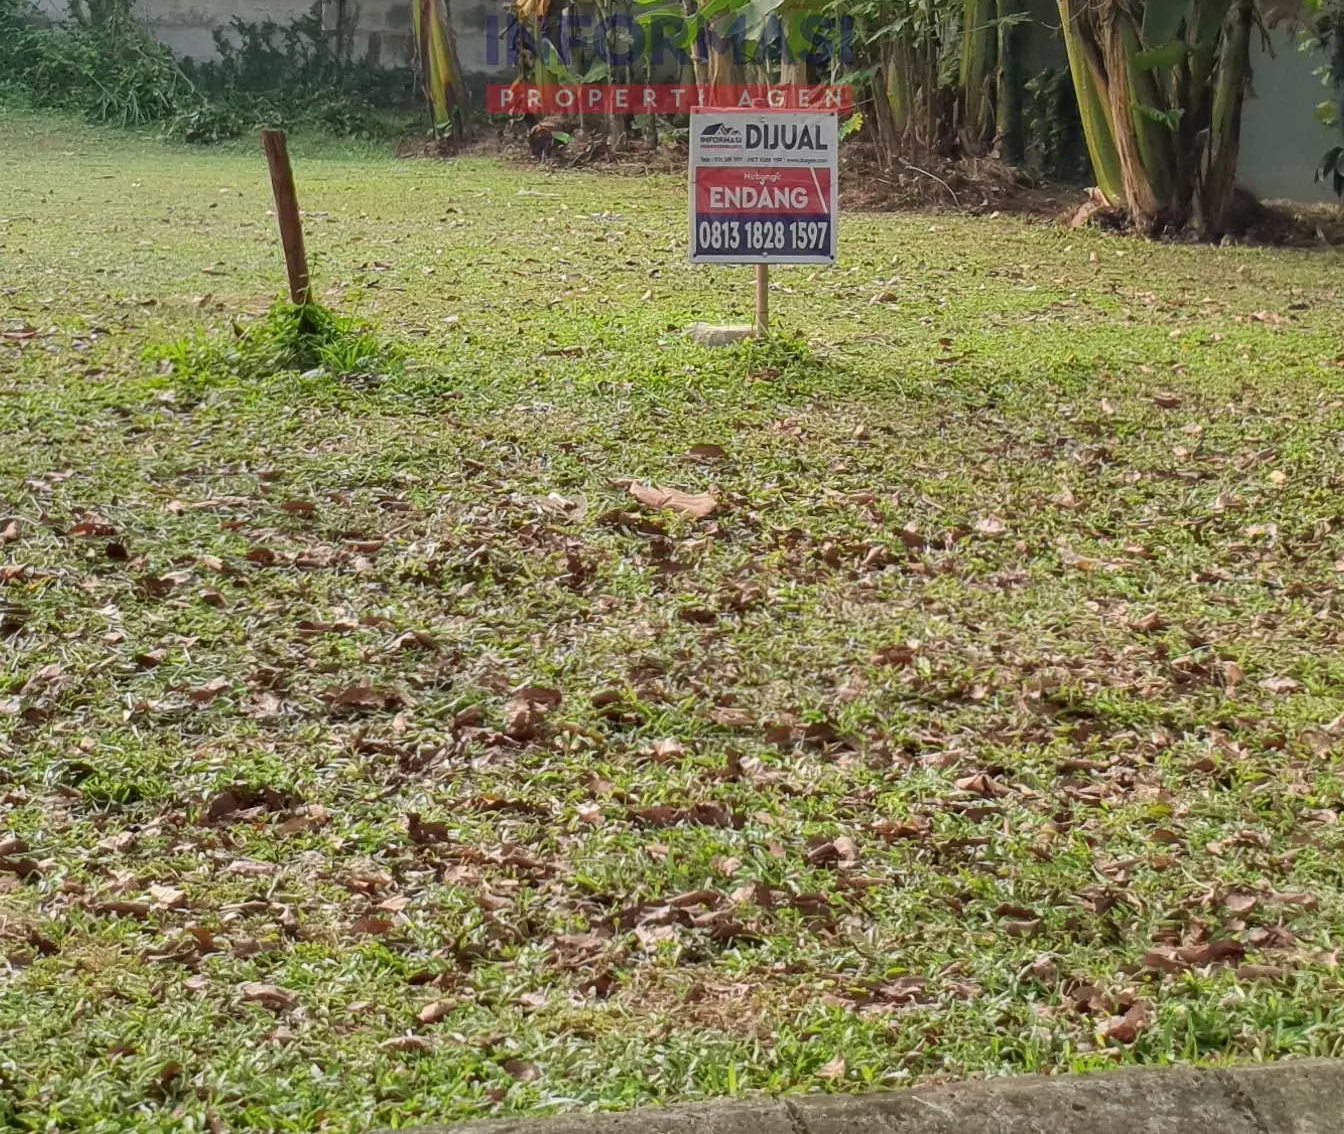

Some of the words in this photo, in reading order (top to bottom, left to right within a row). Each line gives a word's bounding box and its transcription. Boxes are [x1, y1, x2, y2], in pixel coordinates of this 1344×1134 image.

[745, 123, 828, 150] DIJUAL
[709, 186, 809, 209] ENDANG
[699, 221, 741, 250] 0813
[744, 221, 785, 250] 1828
[789, 221, 828, 250] 1597
